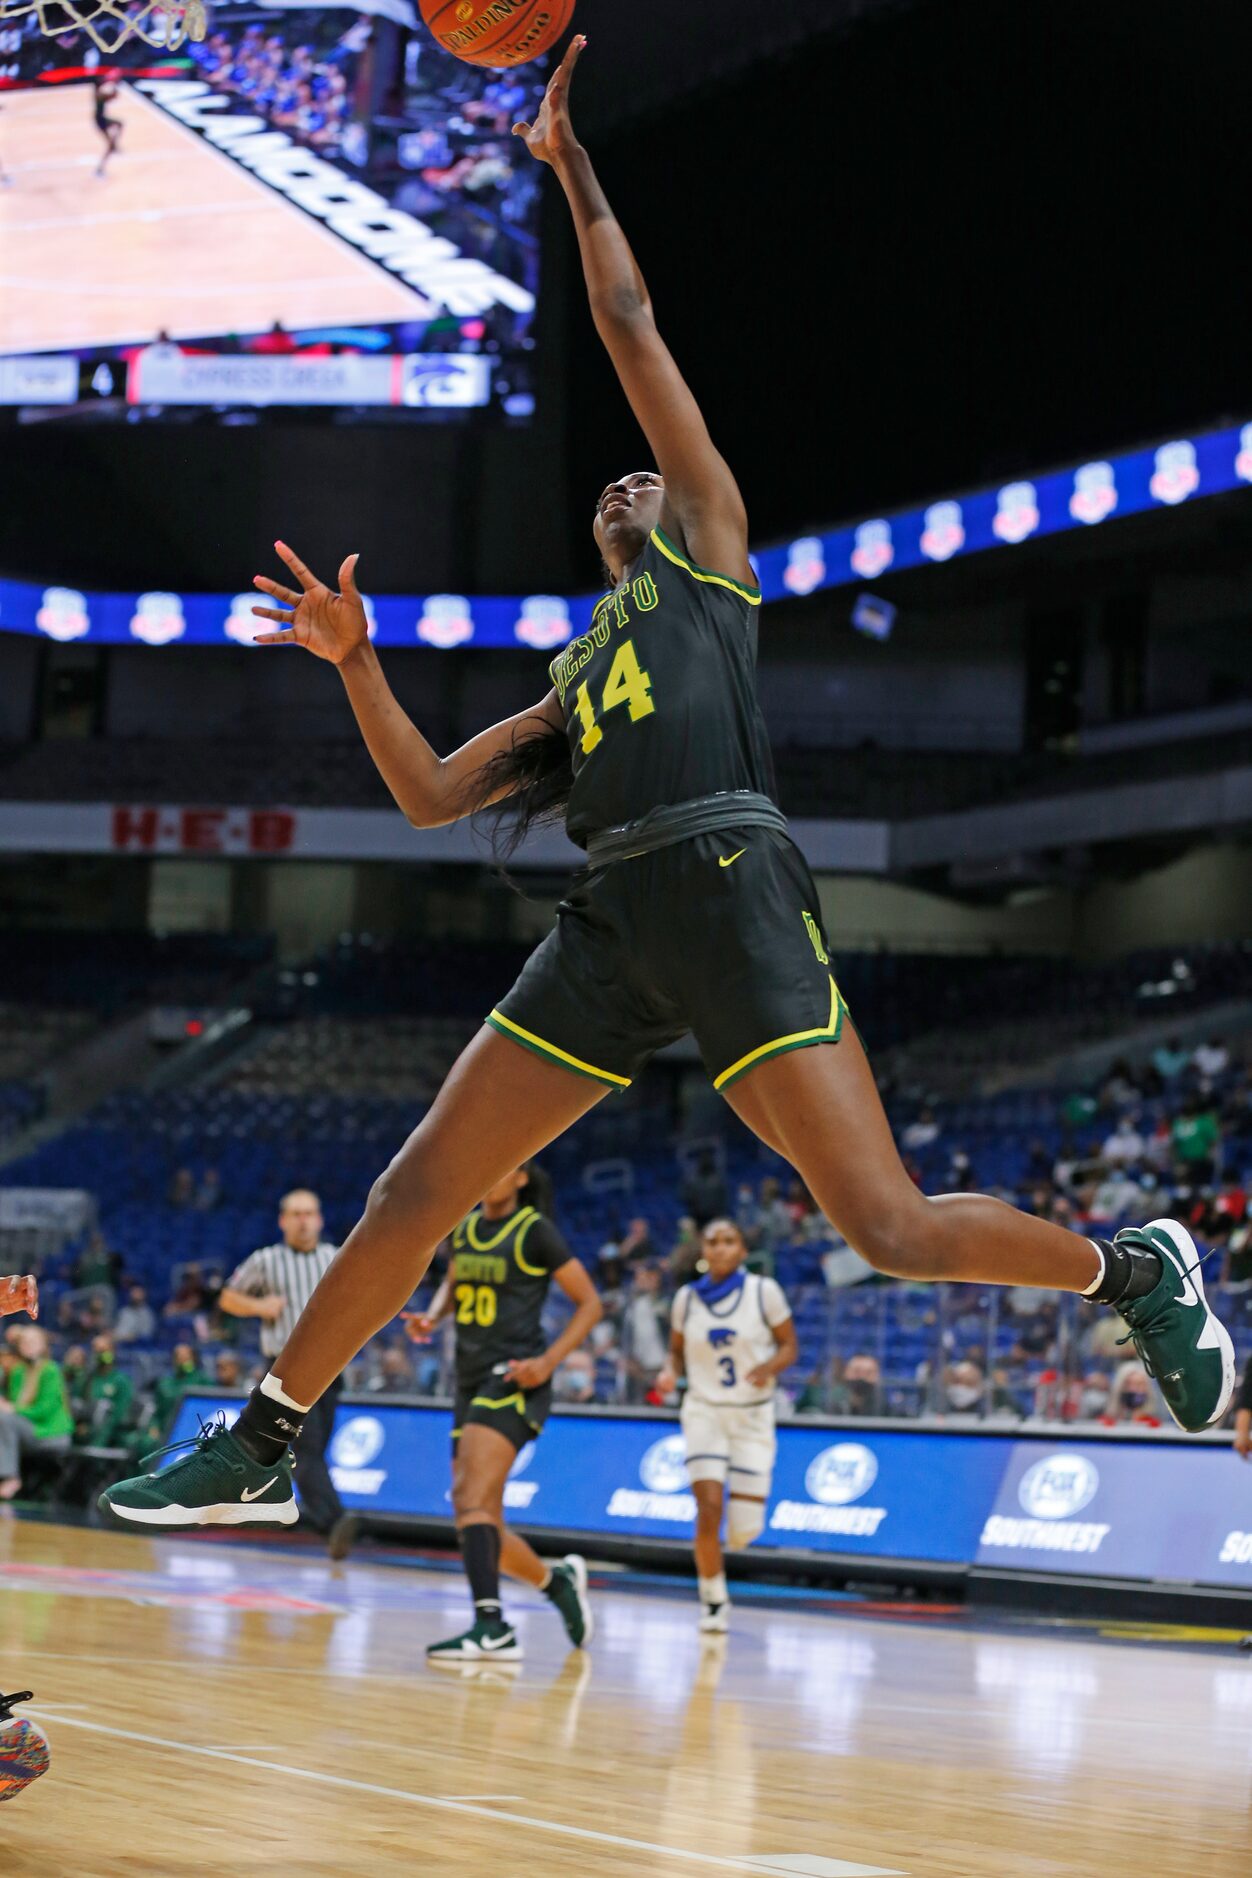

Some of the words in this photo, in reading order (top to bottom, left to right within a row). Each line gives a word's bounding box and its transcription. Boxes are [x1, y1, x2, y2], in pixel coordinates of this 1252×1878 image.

[574, 638, 656, 755] 14
[456, 1284, 497, 1327] 20
[718, 1357, 737, 1387] 3
[769, 1500, 887, 1536] SOUTHWEST
[980, 1514, 1111, 1552] SOUTHWEST
